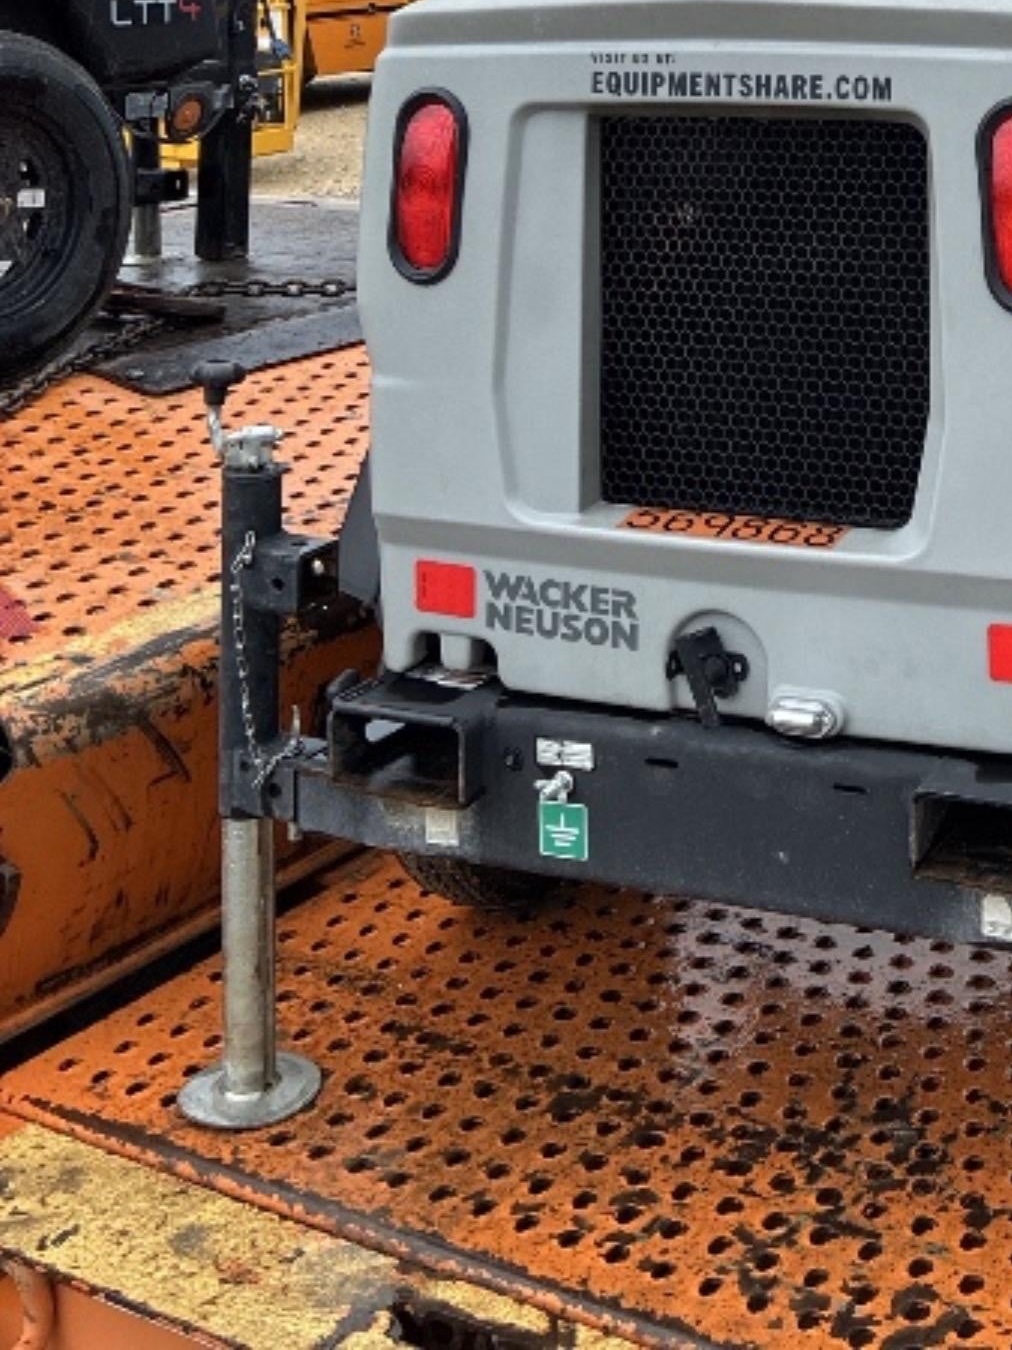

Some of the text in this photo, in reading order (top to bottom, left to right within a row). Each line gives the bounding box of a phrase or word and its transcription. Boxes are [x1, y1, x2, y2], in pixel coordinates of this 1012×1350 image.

[592, 70, 893, 101] EQUIPMENTSHARE.COM
[483, 569, 639, 621] WACKER
[486, 602, 639, 651] NEUSON
